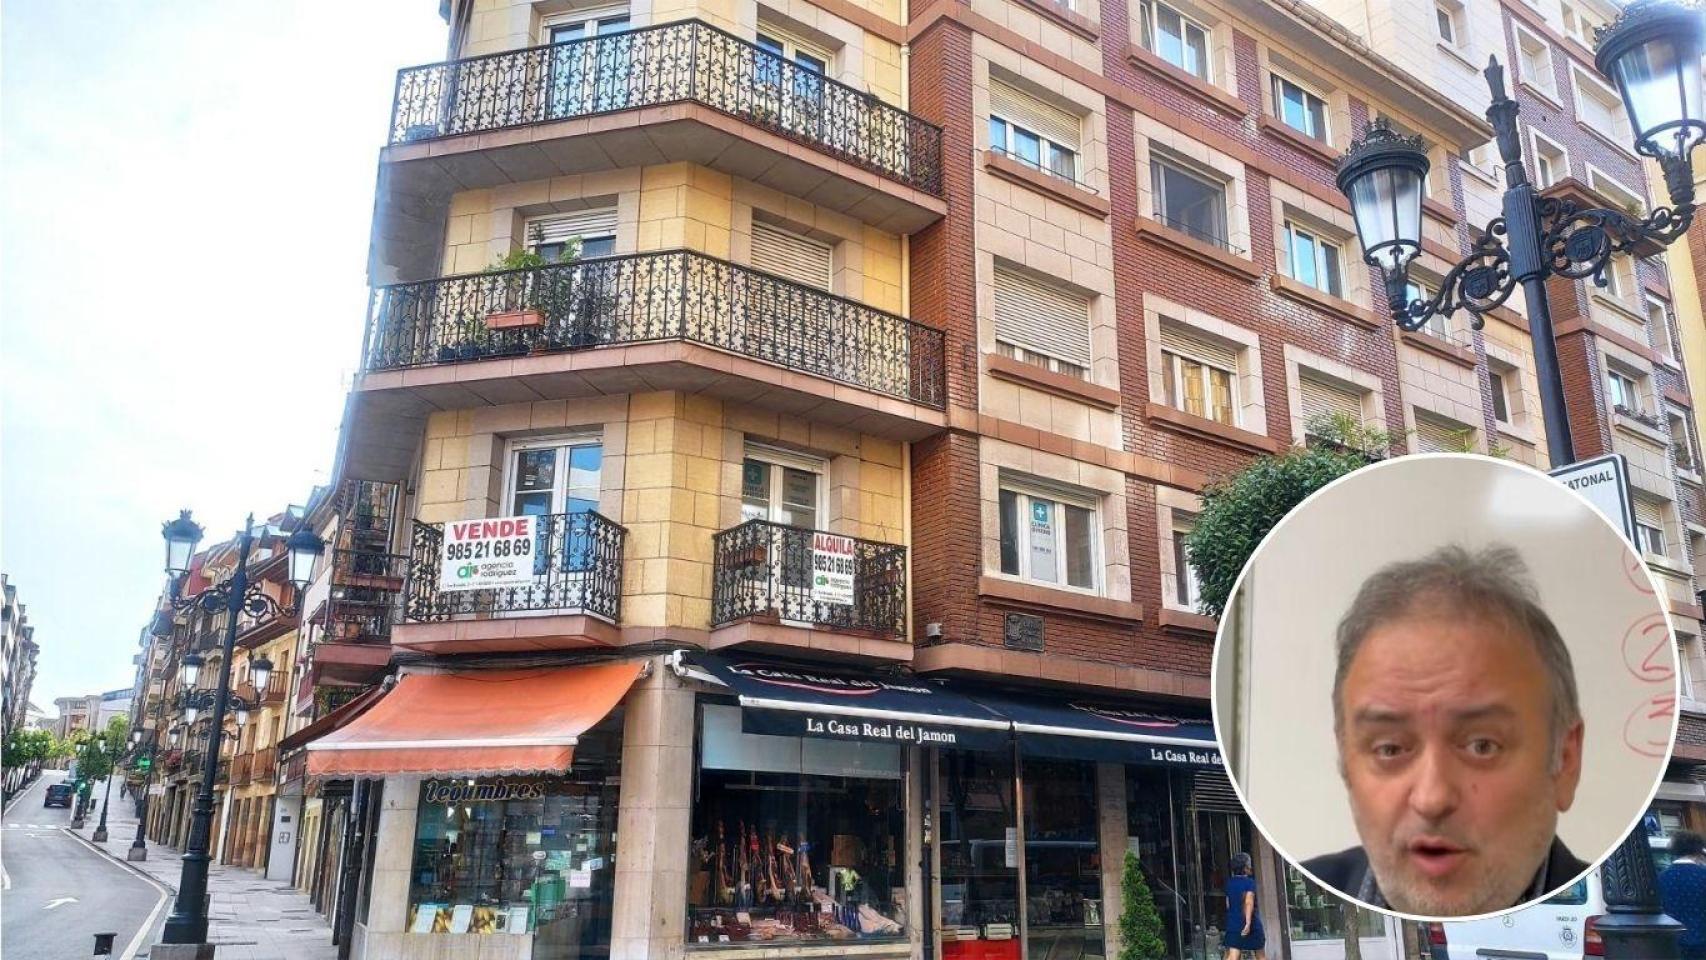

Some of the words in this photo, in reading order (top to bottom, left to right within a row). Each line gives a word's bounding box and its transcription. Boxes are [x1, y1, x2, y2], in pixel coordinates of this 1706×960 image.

[1563, 470, 1613, 490] ATONAL
[453, 519, 528, 540] VENDE
[447, 542, 472, 560] 985
[474, 541, 490, 559] 21
[494, 540, 511, 557] 68
[513, 538, 531, 556] 69
[815, 535, 852, 555] ALQUILA
[481, 562, 514, 571] agencia
[1642, 622, 1671, 672] 2
[806, 718, 824, 733] La
[827, 719, 859, 736] Casa
[863, 722, 892, 739] Real
[895, 725, 915, 740] del
[915, 727, 956, 745] Jamon
[1150, 748, 1164, 761] La
[1165, 749, 1187, 762] Casa
[1189, 751, 1209, 764] Real
